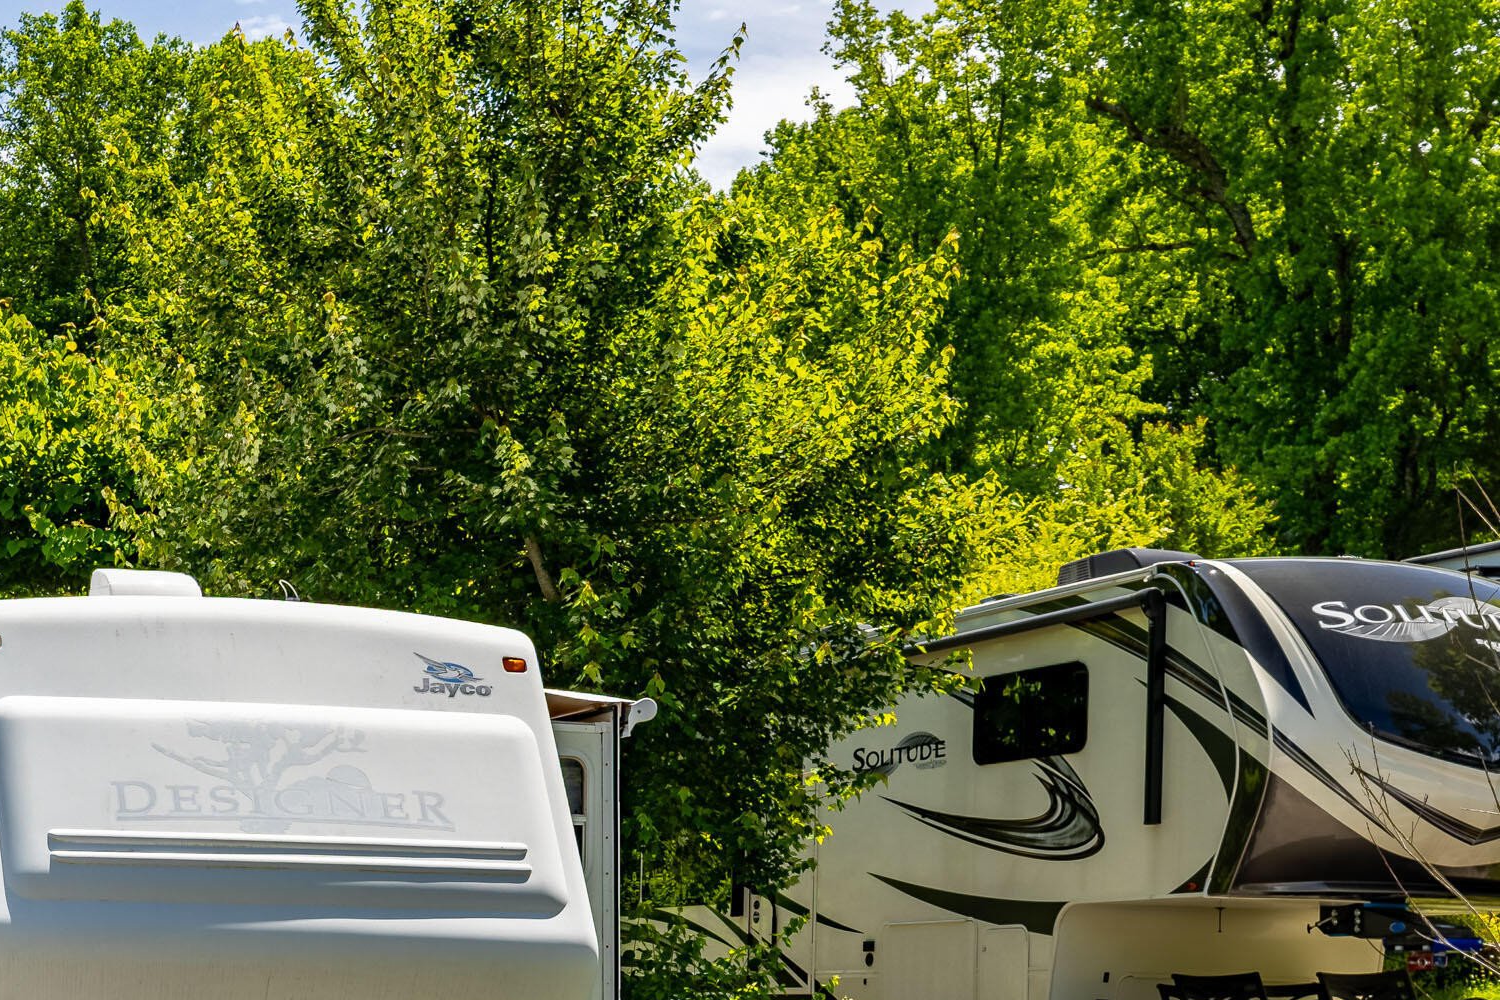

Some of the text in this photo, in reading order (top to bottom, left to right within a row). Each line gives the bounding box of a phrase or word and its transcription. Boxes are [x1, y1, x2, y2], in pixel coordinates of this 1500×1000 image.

[413, 677, 492, 698] Jayco
[852, 740, 946, 773] SOLITUDE
[109, 780, 454, 826] DESIGNER
